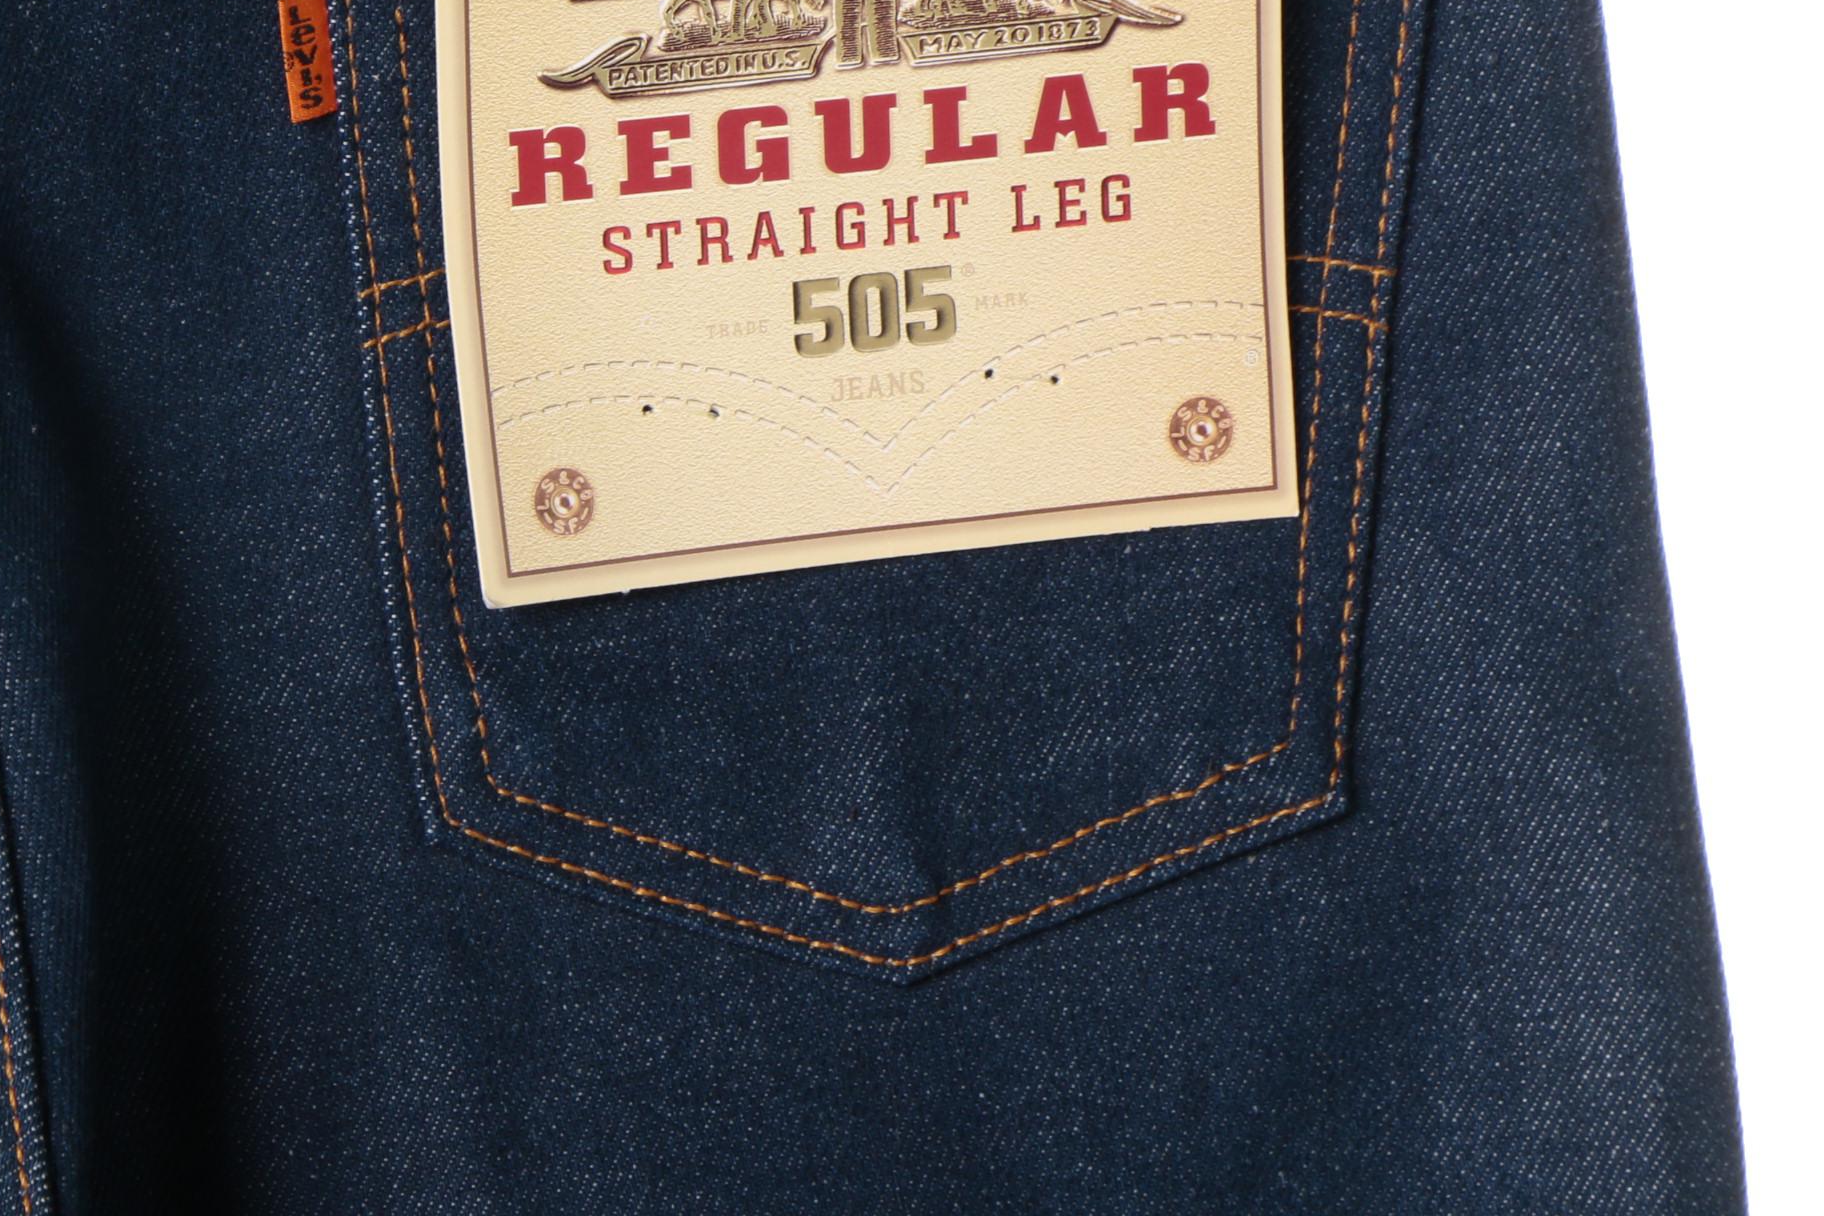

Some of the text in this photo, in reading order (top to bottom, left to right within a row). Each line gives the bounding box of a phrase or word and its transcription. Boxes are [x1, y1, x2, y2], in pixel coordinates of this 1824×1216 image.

[919, 18, 1100, 54] MAY 20 1873
[608, 49, 808, 86] PATENTED IN U.S.
[508, 62, 1216, 208] REGULAR
[601, 173, 1133, 275] STRAIGHT LEG
[976, 292, 1029, 311] MARK
[706, 319, 770, 340] TRADE
[831, 370, 926, 402] JEANS
